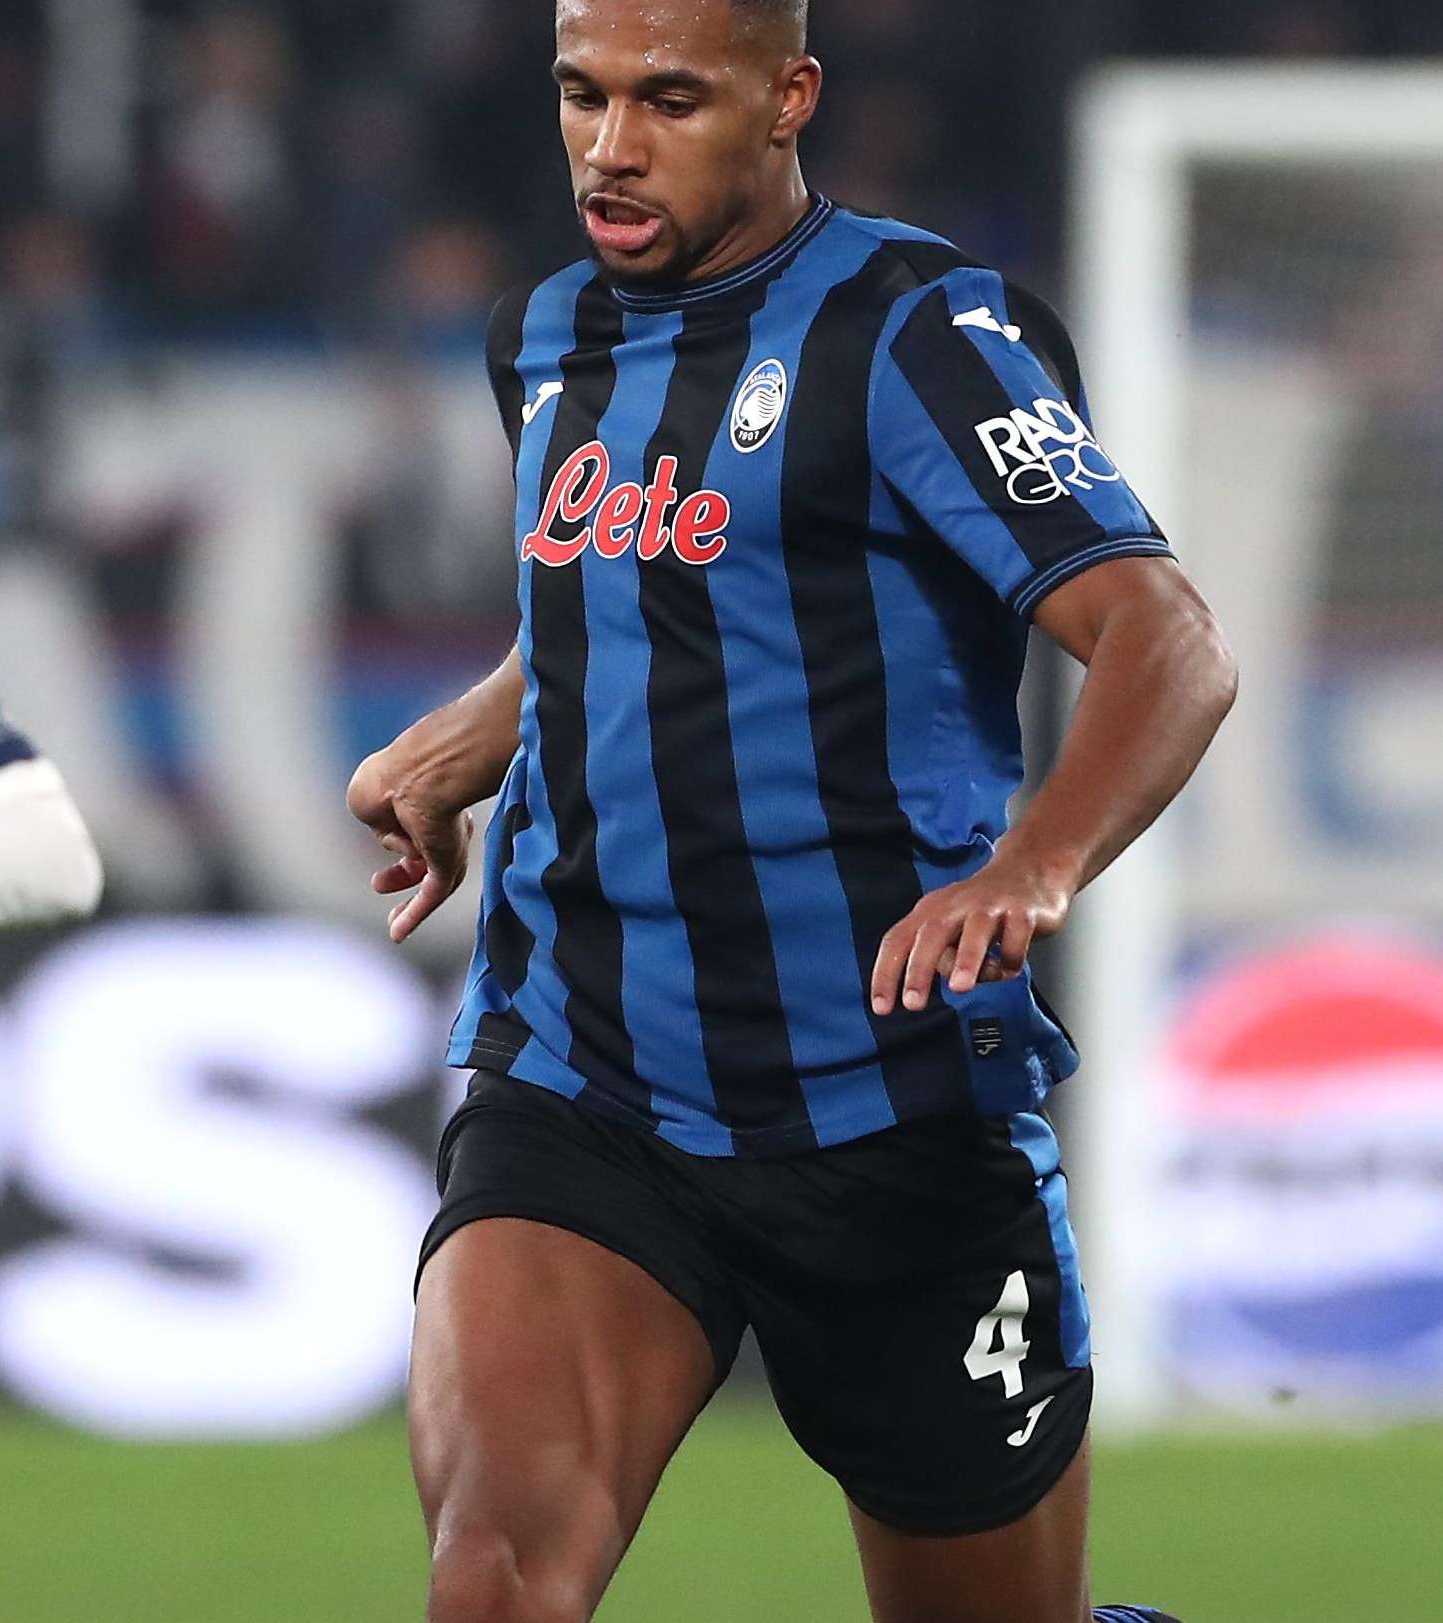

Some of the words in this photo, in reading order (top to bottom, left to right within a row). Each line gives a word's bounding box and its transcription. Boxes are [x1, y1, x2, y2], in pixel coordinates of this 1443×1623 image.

[974, 397, 1096, 477] RADI
[1006, 440, 1120, 504] GRO
[521, 440, 730, 565] Lete
[963, 1269, 1031, 1399] 4
